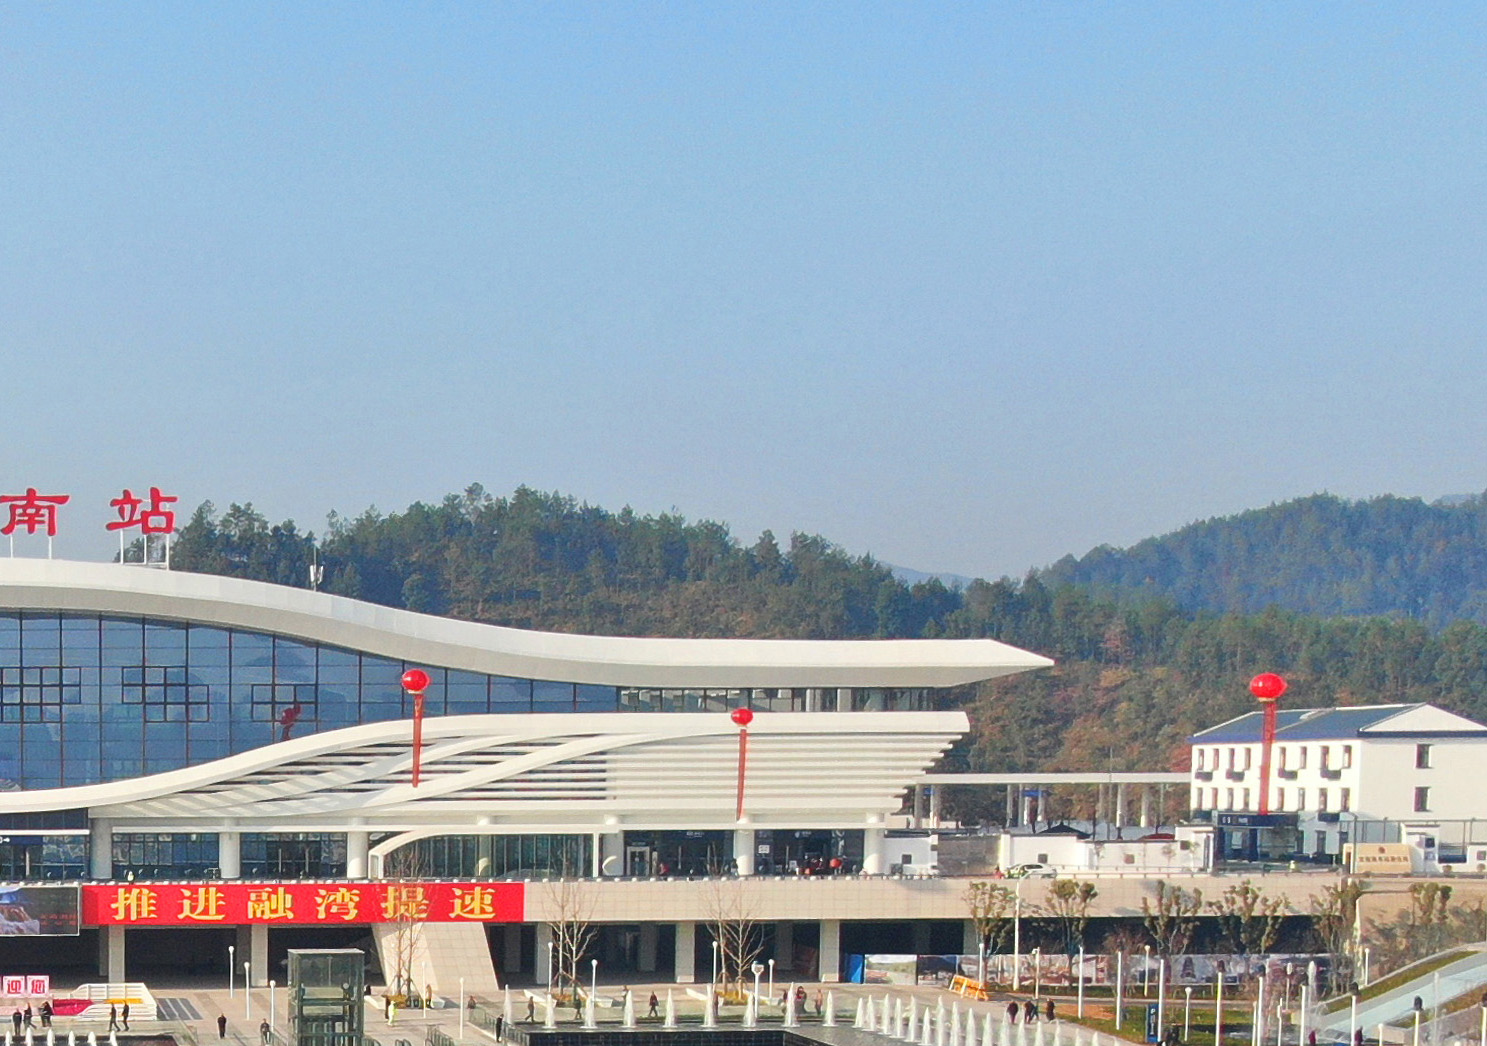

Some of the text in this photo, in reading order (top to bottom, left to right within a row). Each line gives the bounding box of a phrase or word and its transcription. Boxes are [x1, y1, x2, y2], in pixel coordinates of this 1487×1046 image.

[110, 887, 496, 920] 推进融湾提速
